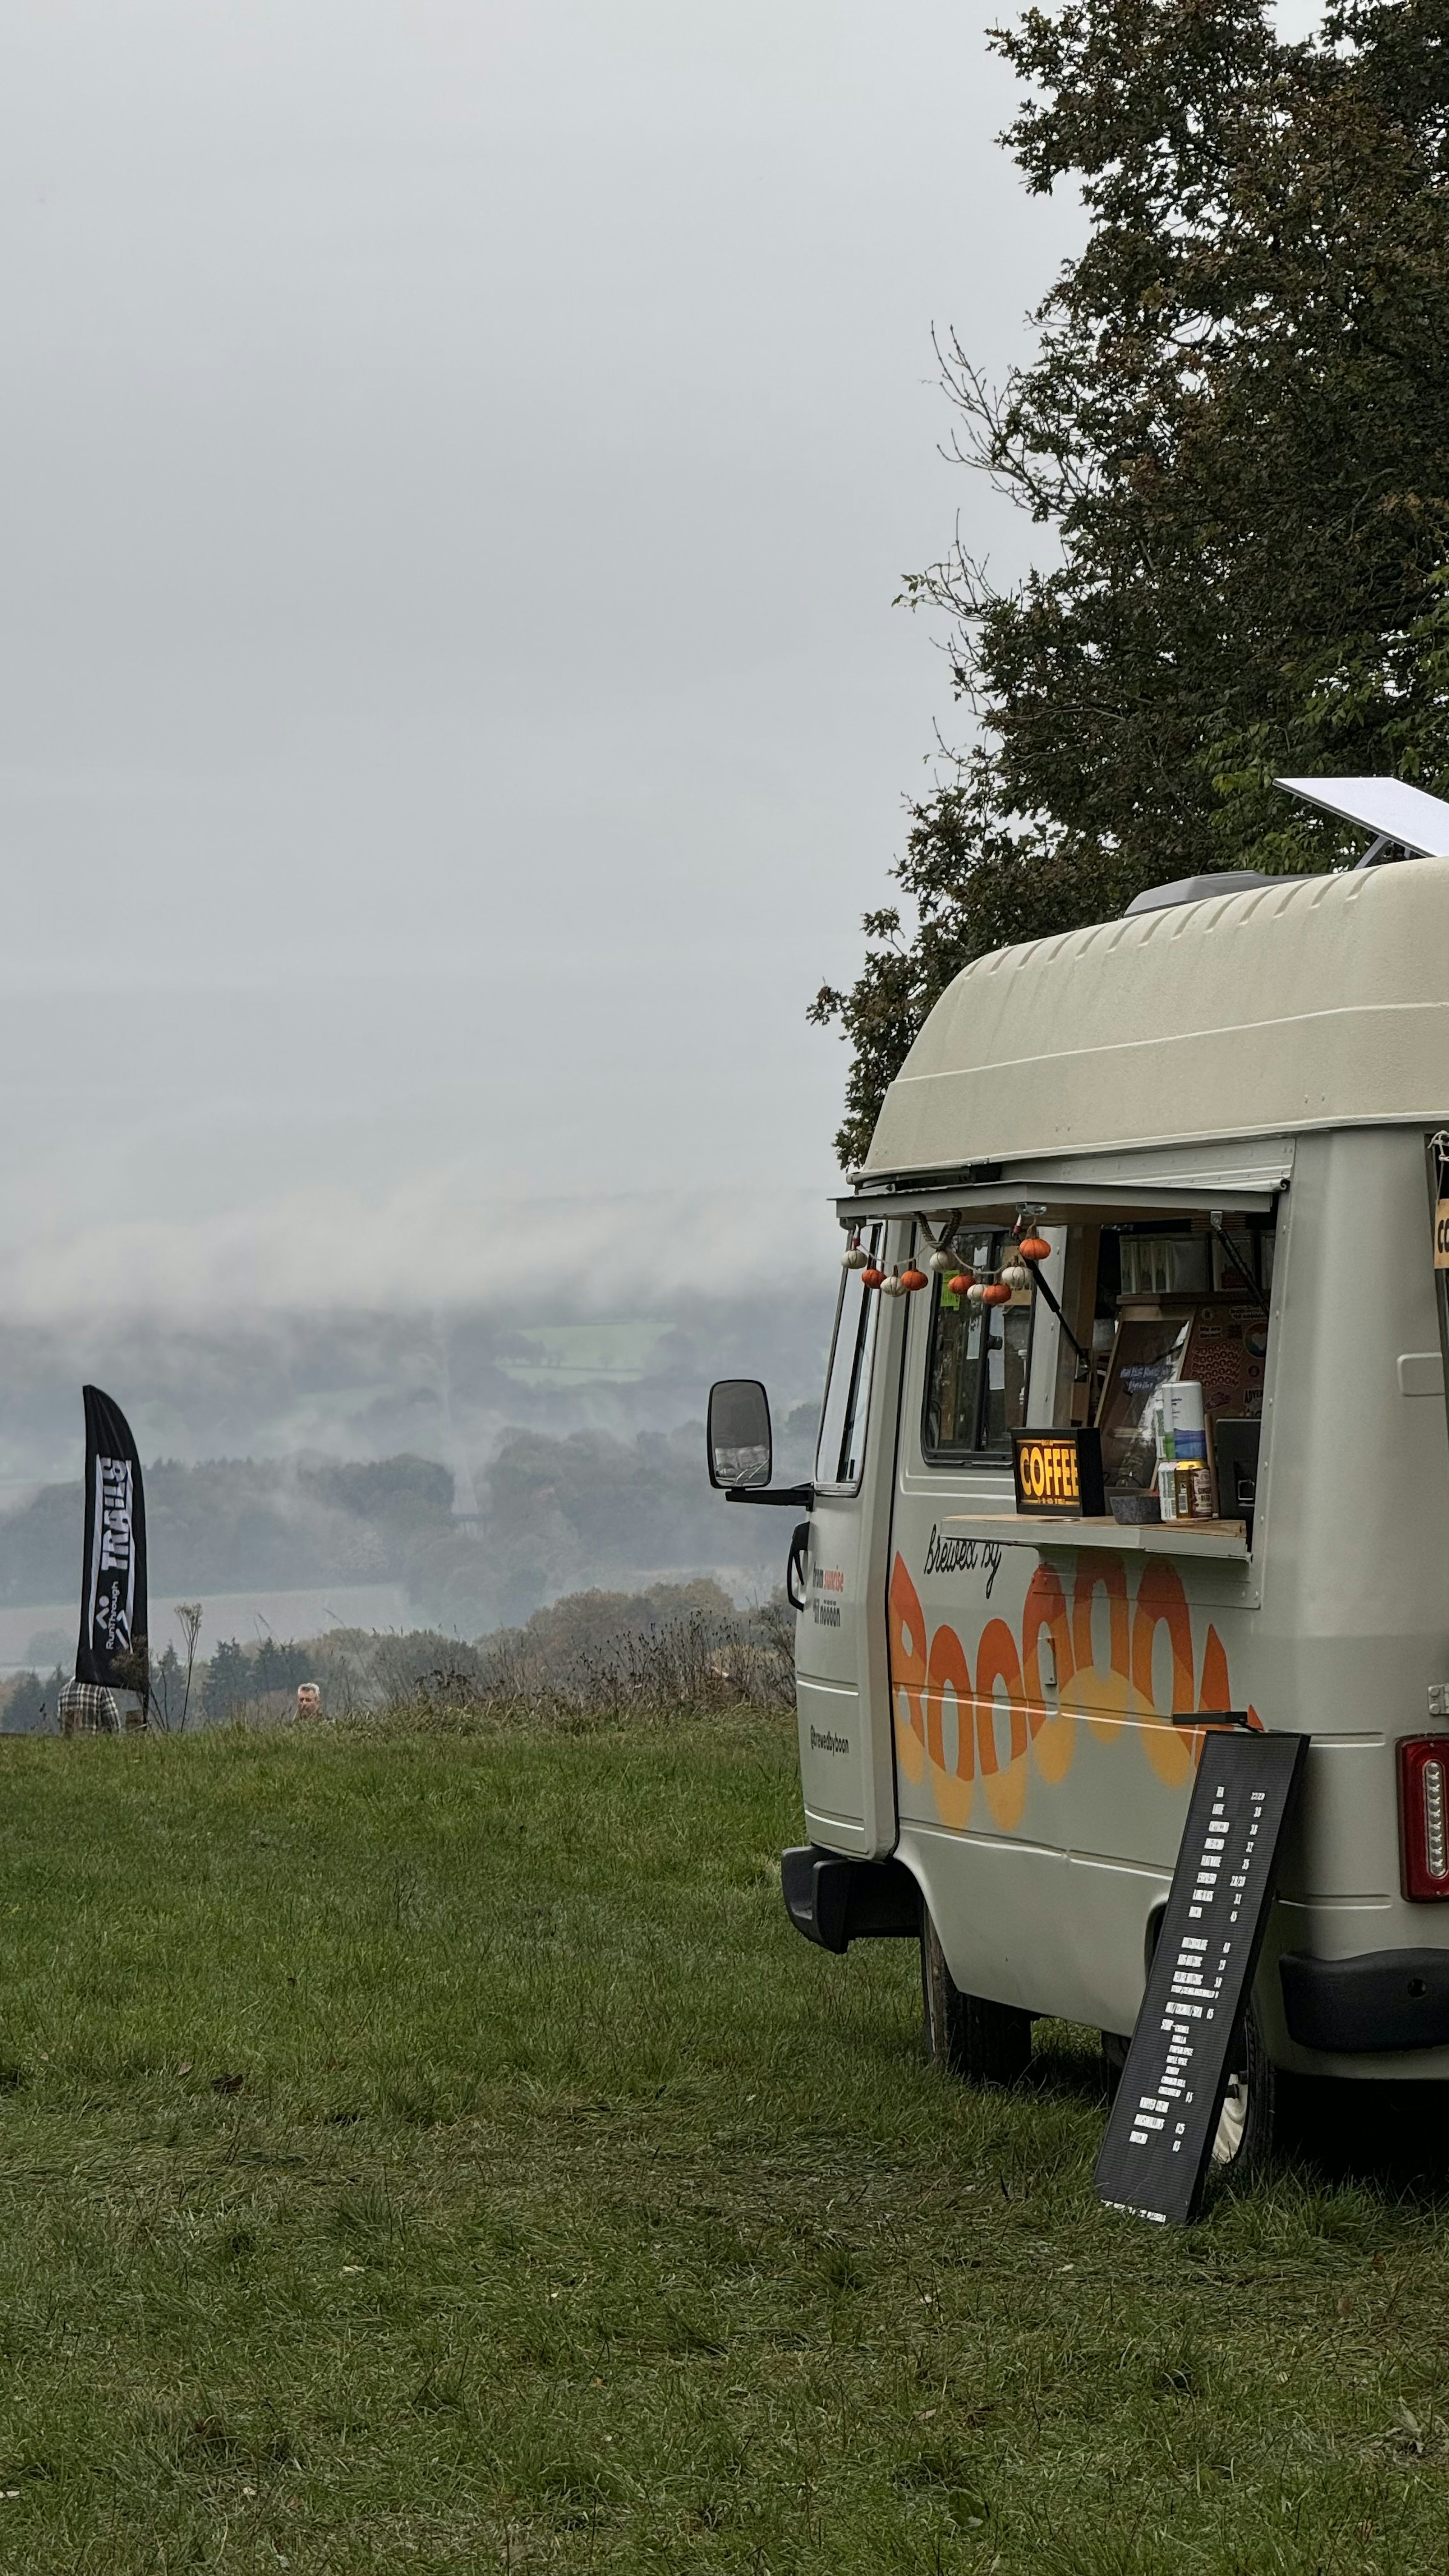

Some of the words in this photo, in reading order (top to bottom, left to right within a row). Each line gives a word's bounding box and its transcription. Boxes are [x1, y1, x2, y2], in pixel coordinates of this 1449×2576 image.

[1020, 1447, 1079, 1496] COFFEE
[100, 1457, 129, 1571] TRAILS
[106, 1581, 120, 1650] RunThrough
[811, 1724, 849, 1757] @brewedbyboon
